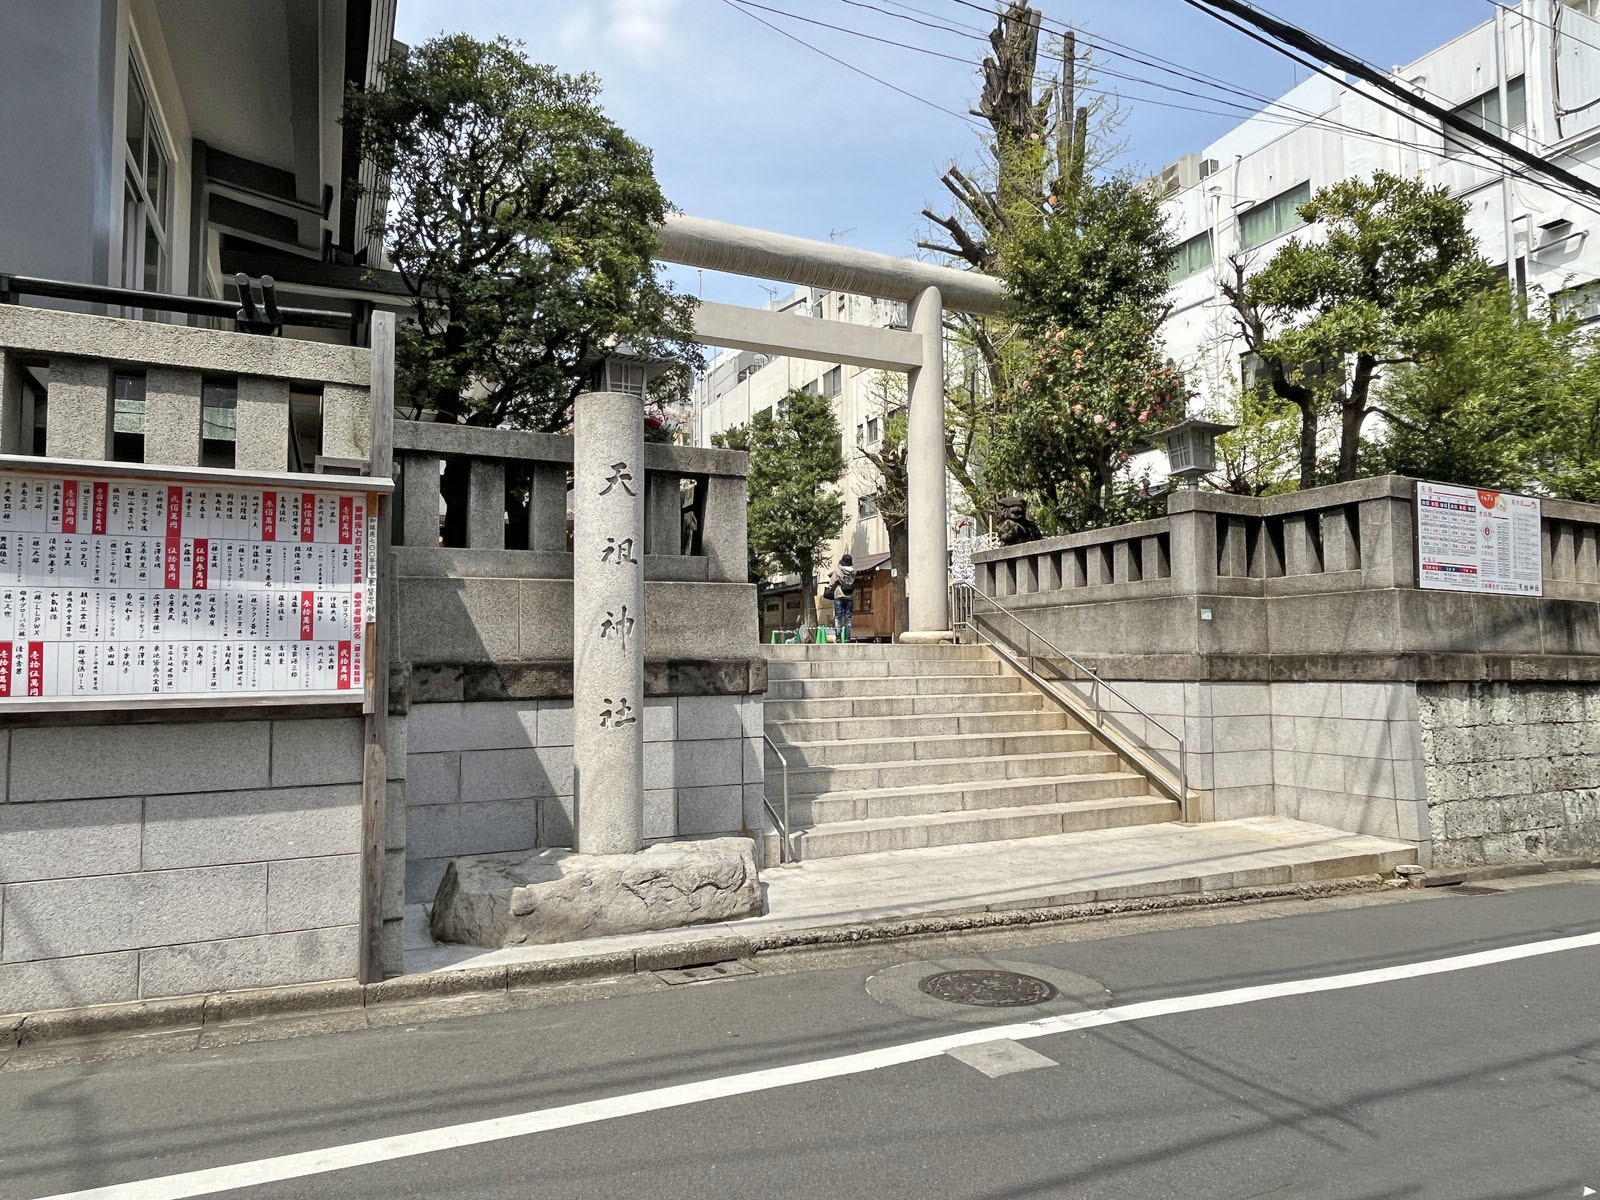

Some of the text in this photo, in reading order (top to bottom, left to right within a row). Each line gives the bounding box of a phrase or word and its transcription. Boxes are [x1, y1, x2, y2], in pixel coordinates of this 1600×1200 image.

[598, 461, 637, 728] 天祖神社
[30, 650, 40, 696] 壱拾伍萬円
